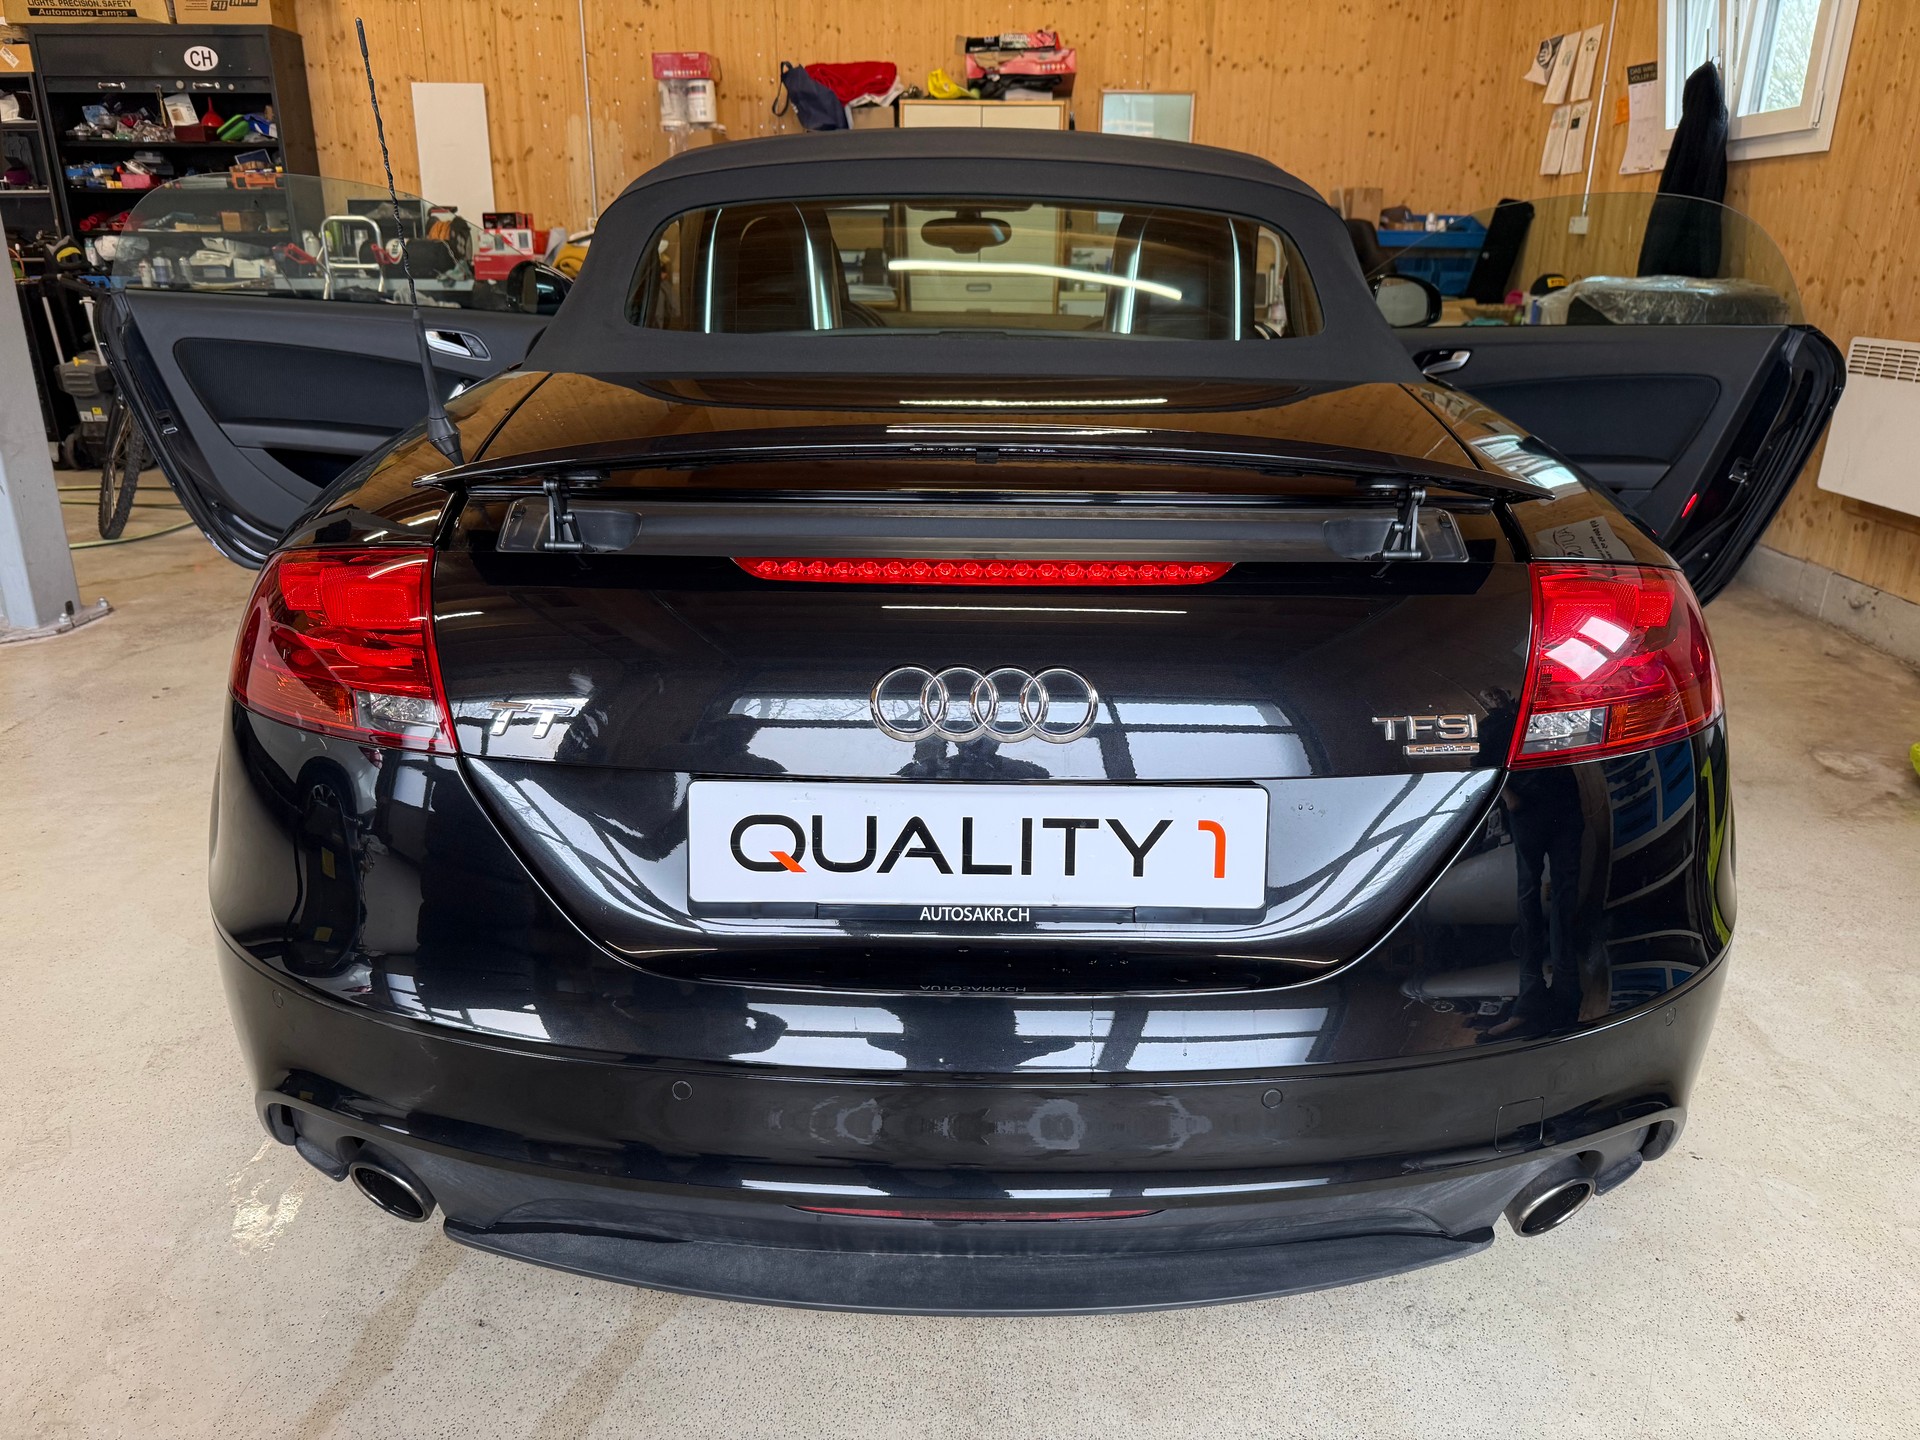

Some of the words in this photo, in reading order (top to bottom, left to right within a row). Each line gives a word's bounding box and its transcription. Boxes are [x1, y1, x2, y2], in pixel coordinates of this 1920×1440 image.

[102, 0, 132, 8] SAFETY
[38, 8, 94, 17] Automotive
[96, 9, 128, 18] Lamps
[189, 50, 213, 67] CH
[487, 702, 575, 739] TT
[1371, 713, 1479, 741] TFSI
[730, 813, 1174, 878] QUALITY
[1198, 819, 1227, 879] 1
[919, 906, 1030, 922] AUTOSAKR.CH
